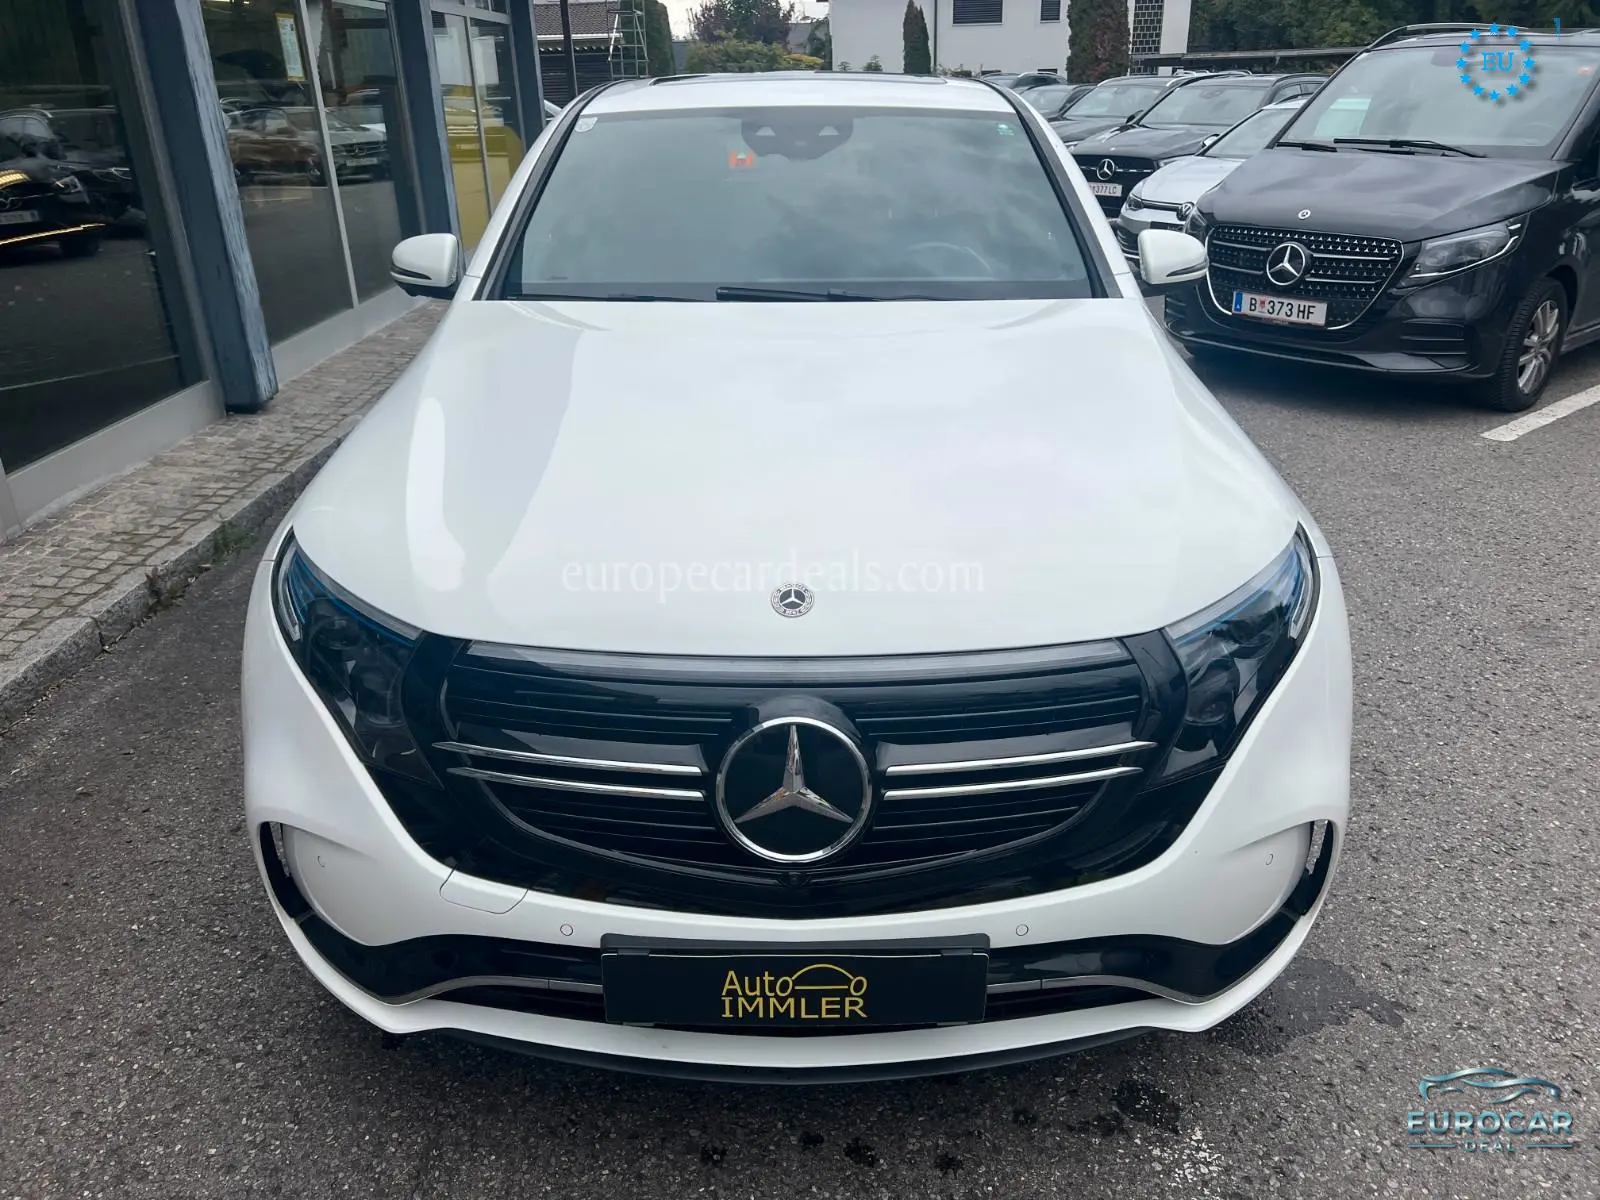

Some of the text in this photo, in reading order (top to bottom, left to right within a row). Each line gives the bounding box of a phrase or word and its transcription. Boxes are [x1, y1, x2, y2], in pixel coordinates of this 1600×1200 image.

[1248, 297, 1258, 312] B
[1267, 300, 1293, 317] 373
[1296, 304, 1316, 320] HF
[721, 997, 868, 1018] IMMLER
